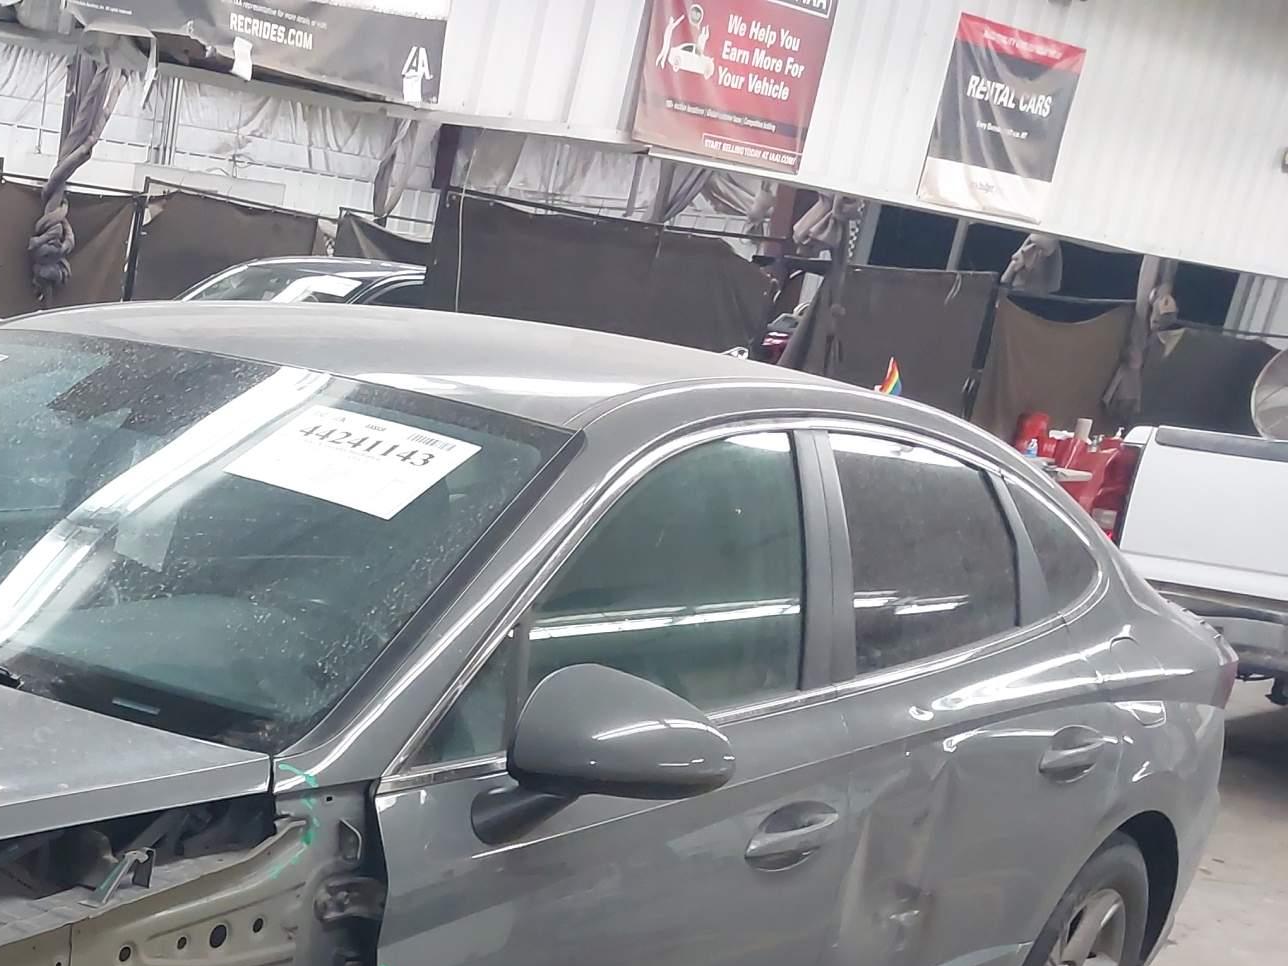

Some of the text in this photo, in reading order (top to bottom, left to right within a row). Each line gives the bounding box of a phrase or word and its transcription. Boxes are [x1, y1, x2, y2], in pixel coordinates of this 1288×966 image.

[230, 13, 313, 50] RECRIDES.COM
[727, 14, 801, 52] We Help You
[722, 40, 805, 78] Earn More For
[717, 65, 790, 101] Your Vehicle
[966, 74, 1052, 118] RENTAL CARS
[299, 424, 435, 467] 44241143
